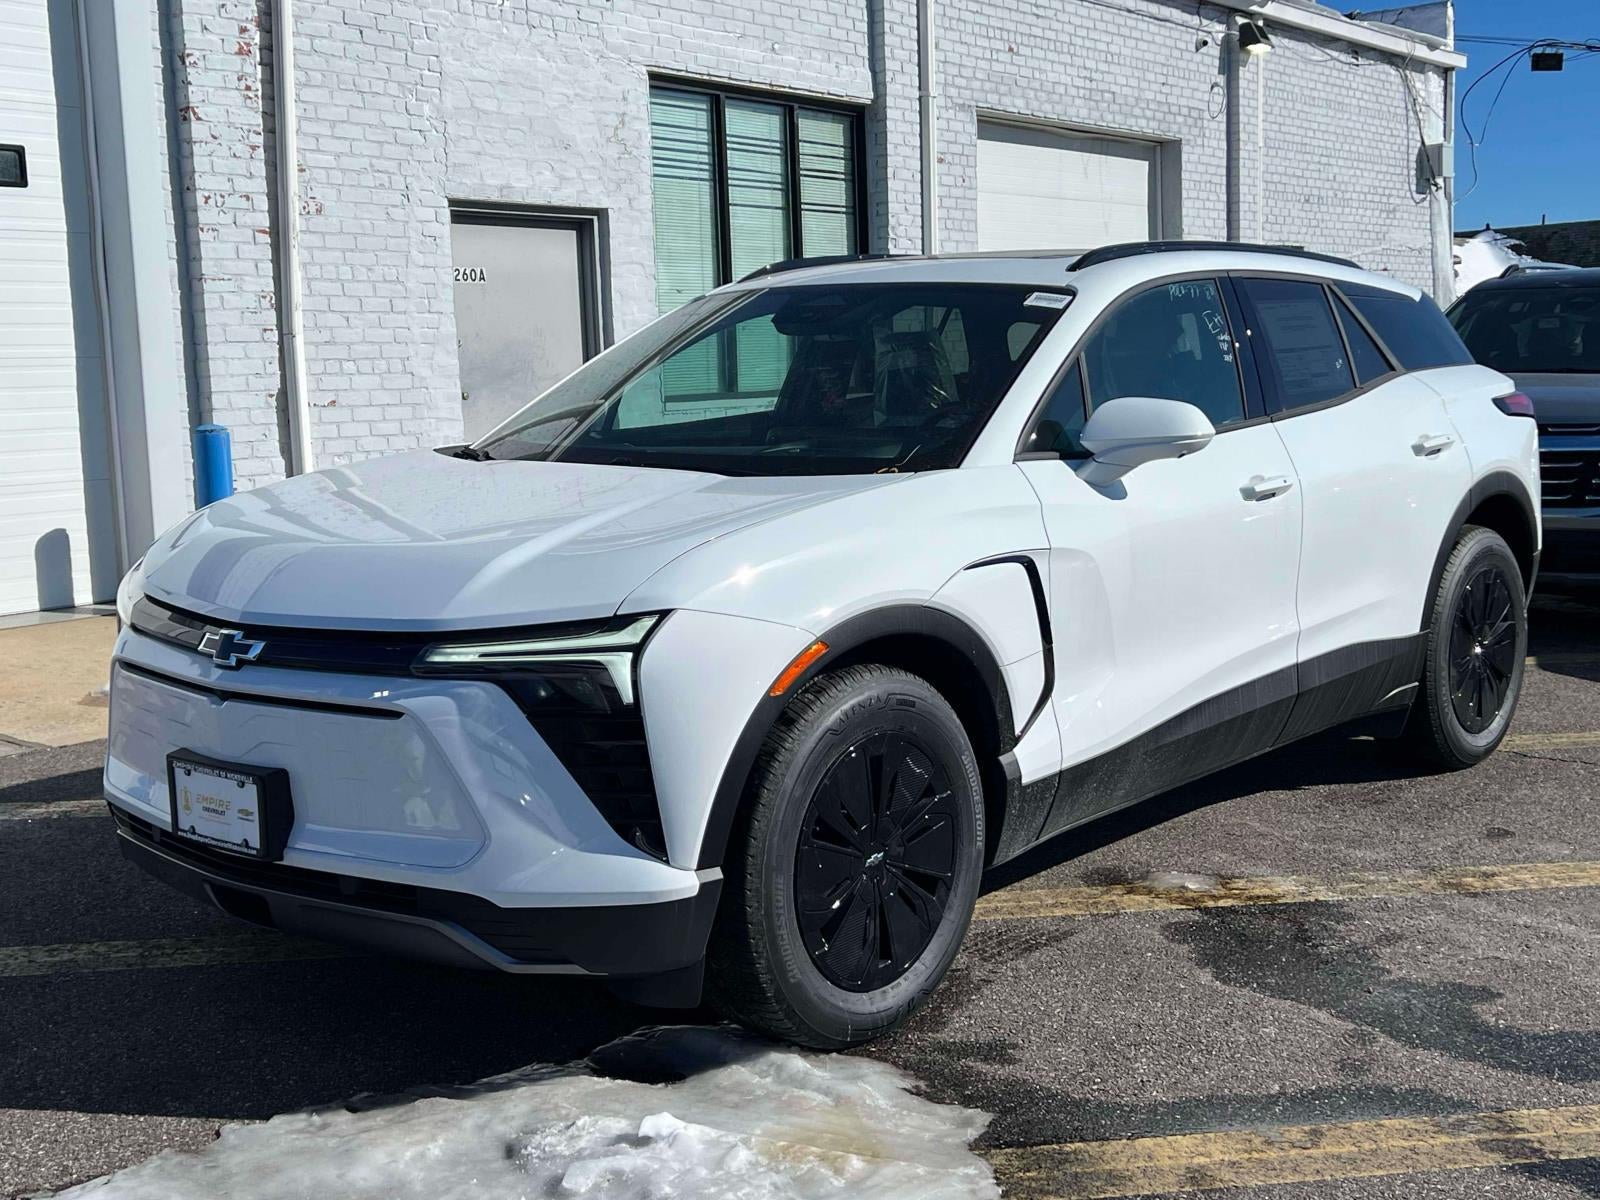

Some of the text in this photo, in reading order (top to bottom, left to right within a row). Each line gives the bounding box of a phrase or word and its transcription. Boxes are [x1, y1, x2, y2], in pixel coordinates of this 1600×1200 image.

[454, 268, 486, 282] 260A
[196, 793, 232, 811] EMPIRE
[202, 806, 226, 816] CHEVROLET
